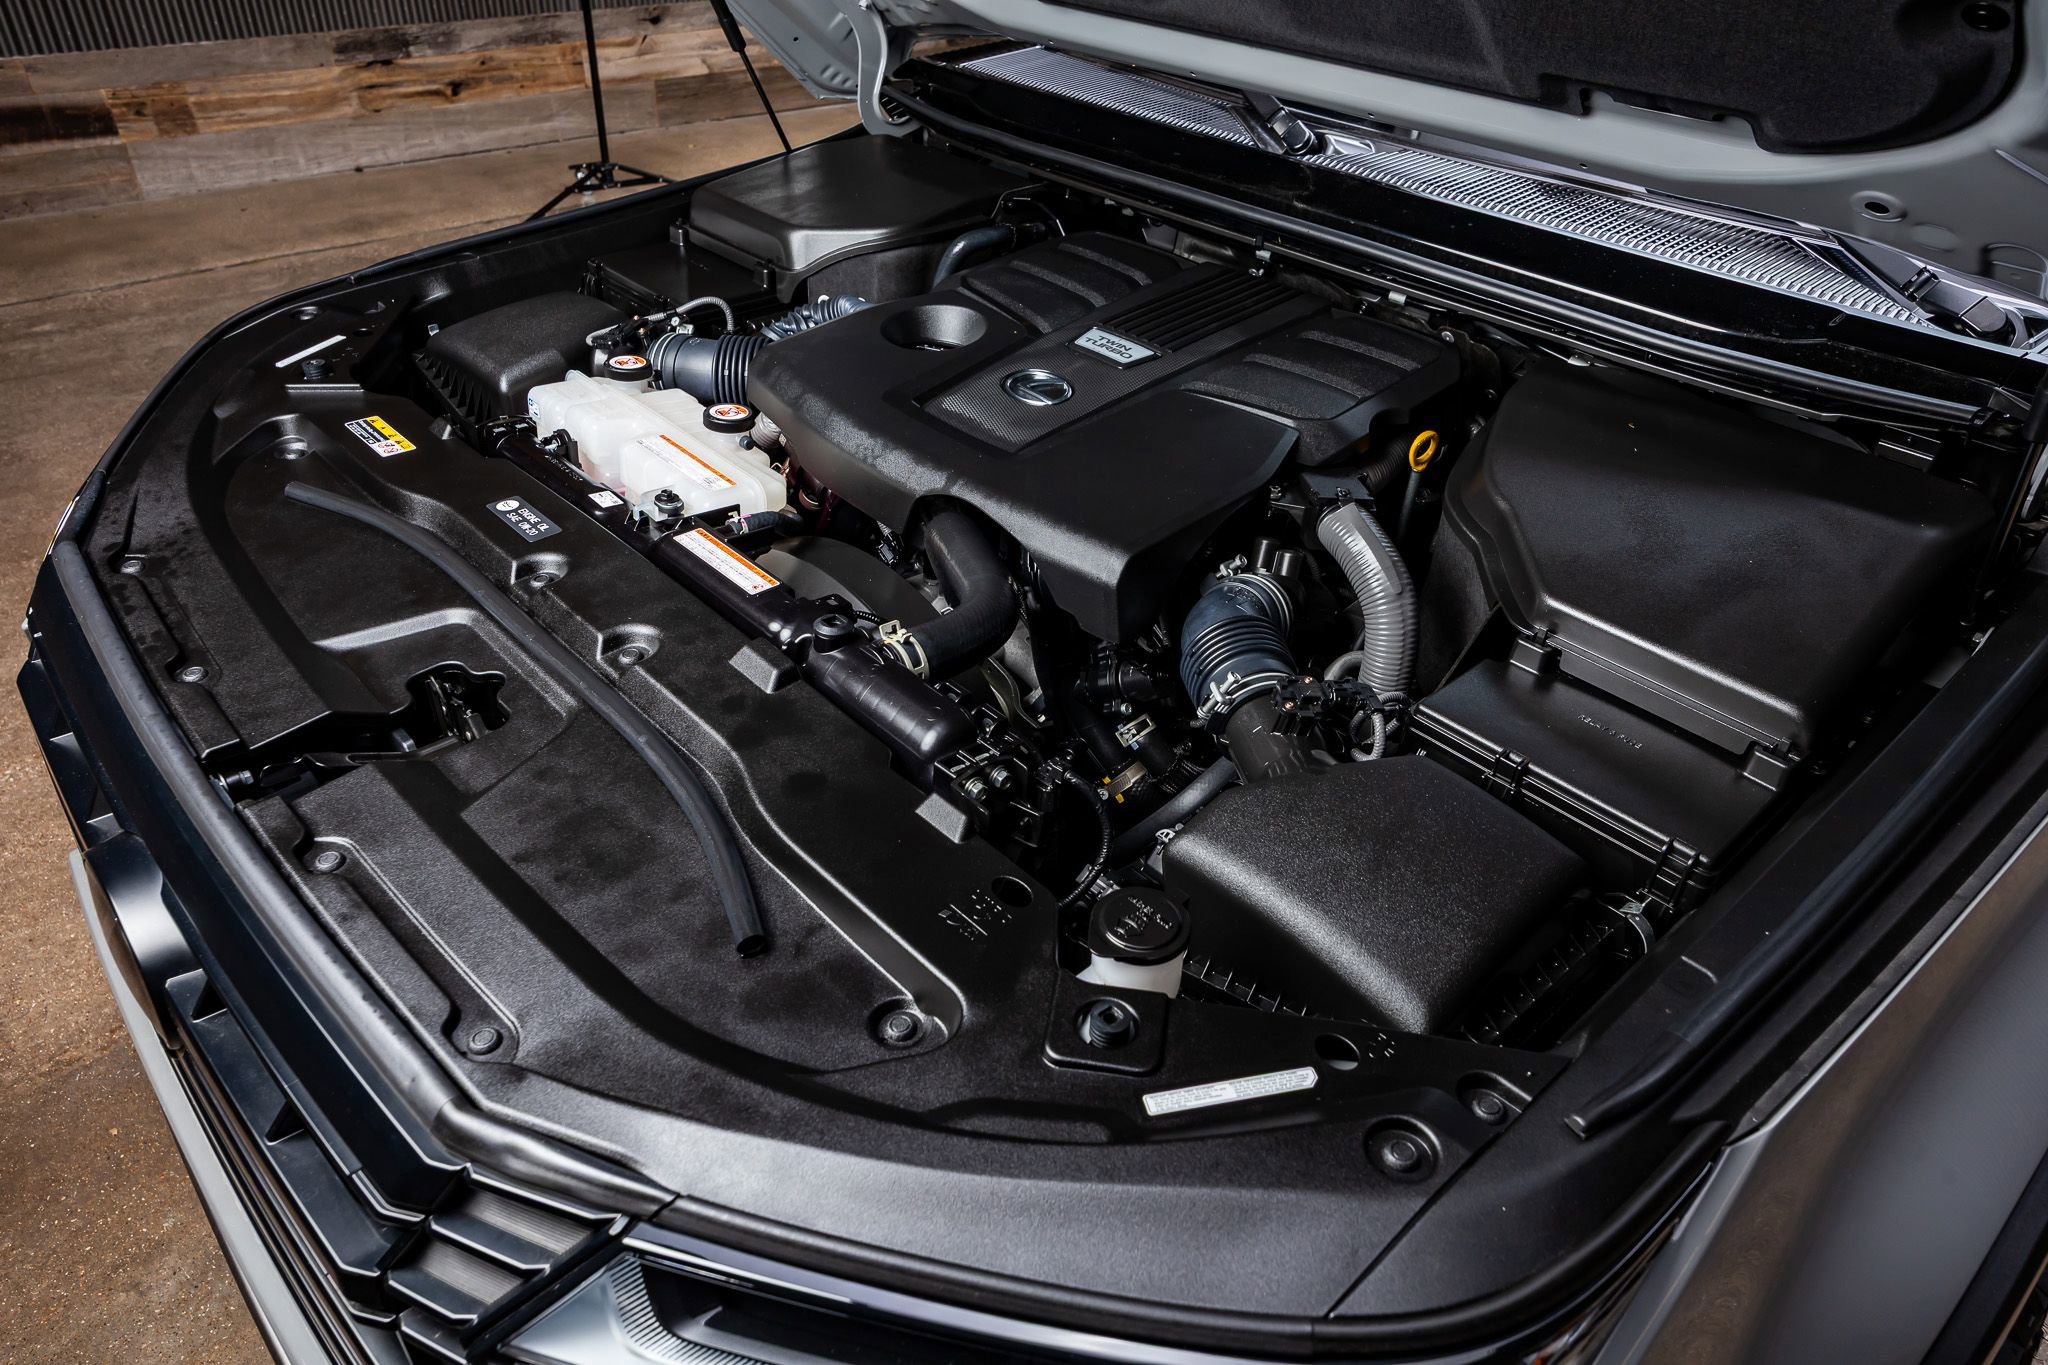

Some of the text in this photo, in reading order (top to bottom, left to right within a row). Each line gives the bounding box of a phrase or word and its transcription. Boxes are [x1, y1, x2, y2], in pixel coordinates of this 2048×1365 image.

[1086, 337, 1132, 359] TURBO
[1099, 335, 1132, 351] TWIN
[506, 512, 539, 536] SAE 0W-20
[518, 508, 550, 532] ENGINE OIL
